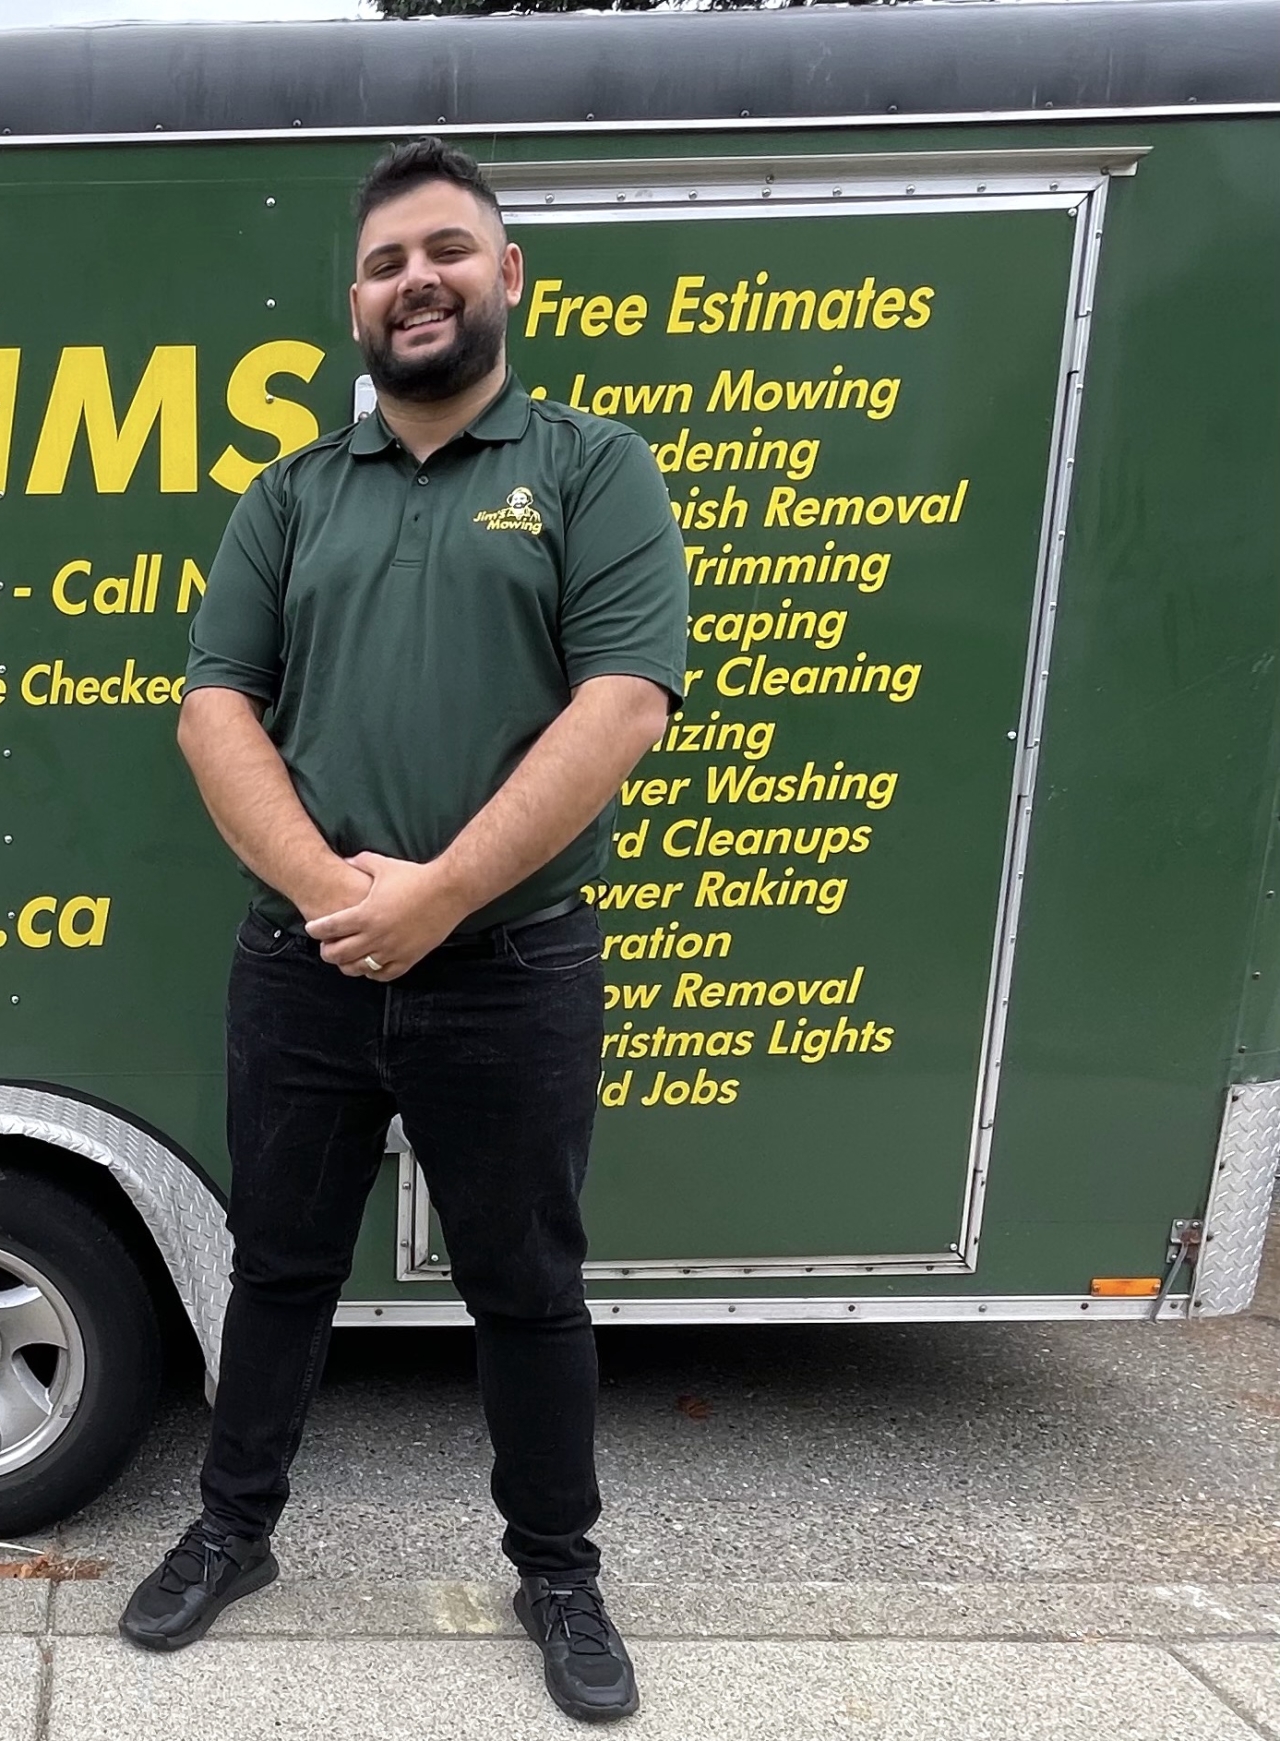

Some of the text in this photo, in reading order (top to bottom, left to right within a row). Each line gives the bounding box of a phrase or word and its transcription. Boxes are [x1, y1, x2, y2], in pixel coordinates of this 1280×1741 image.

[524, 270, 935, 338] Free Estimates
[569, 364, 901, 420] Lawn Mowing
[650, 426, 820, 481] dening
[472, 510, 507, 523] Jim's
[486, 517, 543, 535] Mowing
[763, 479, 969, 528] Removal
[51, 553, 163, 616] Call
[683, 540, 891, 593] Trimming
[686, 598, 848, 649] caping
[716, 653, 922, 702] Cleaning
[707, 761, 898, 809] Washing
[662, 817, 873, 864] Cleanups
[580, 866, 848, 913] wer Raking
[601, 920, 732, 961] ration
[604, 966, 864, 1010] ow Removal
[602, 1016, 894, 1064] ristmas Lights
[641, 1068, 740, 1106] Jobs
